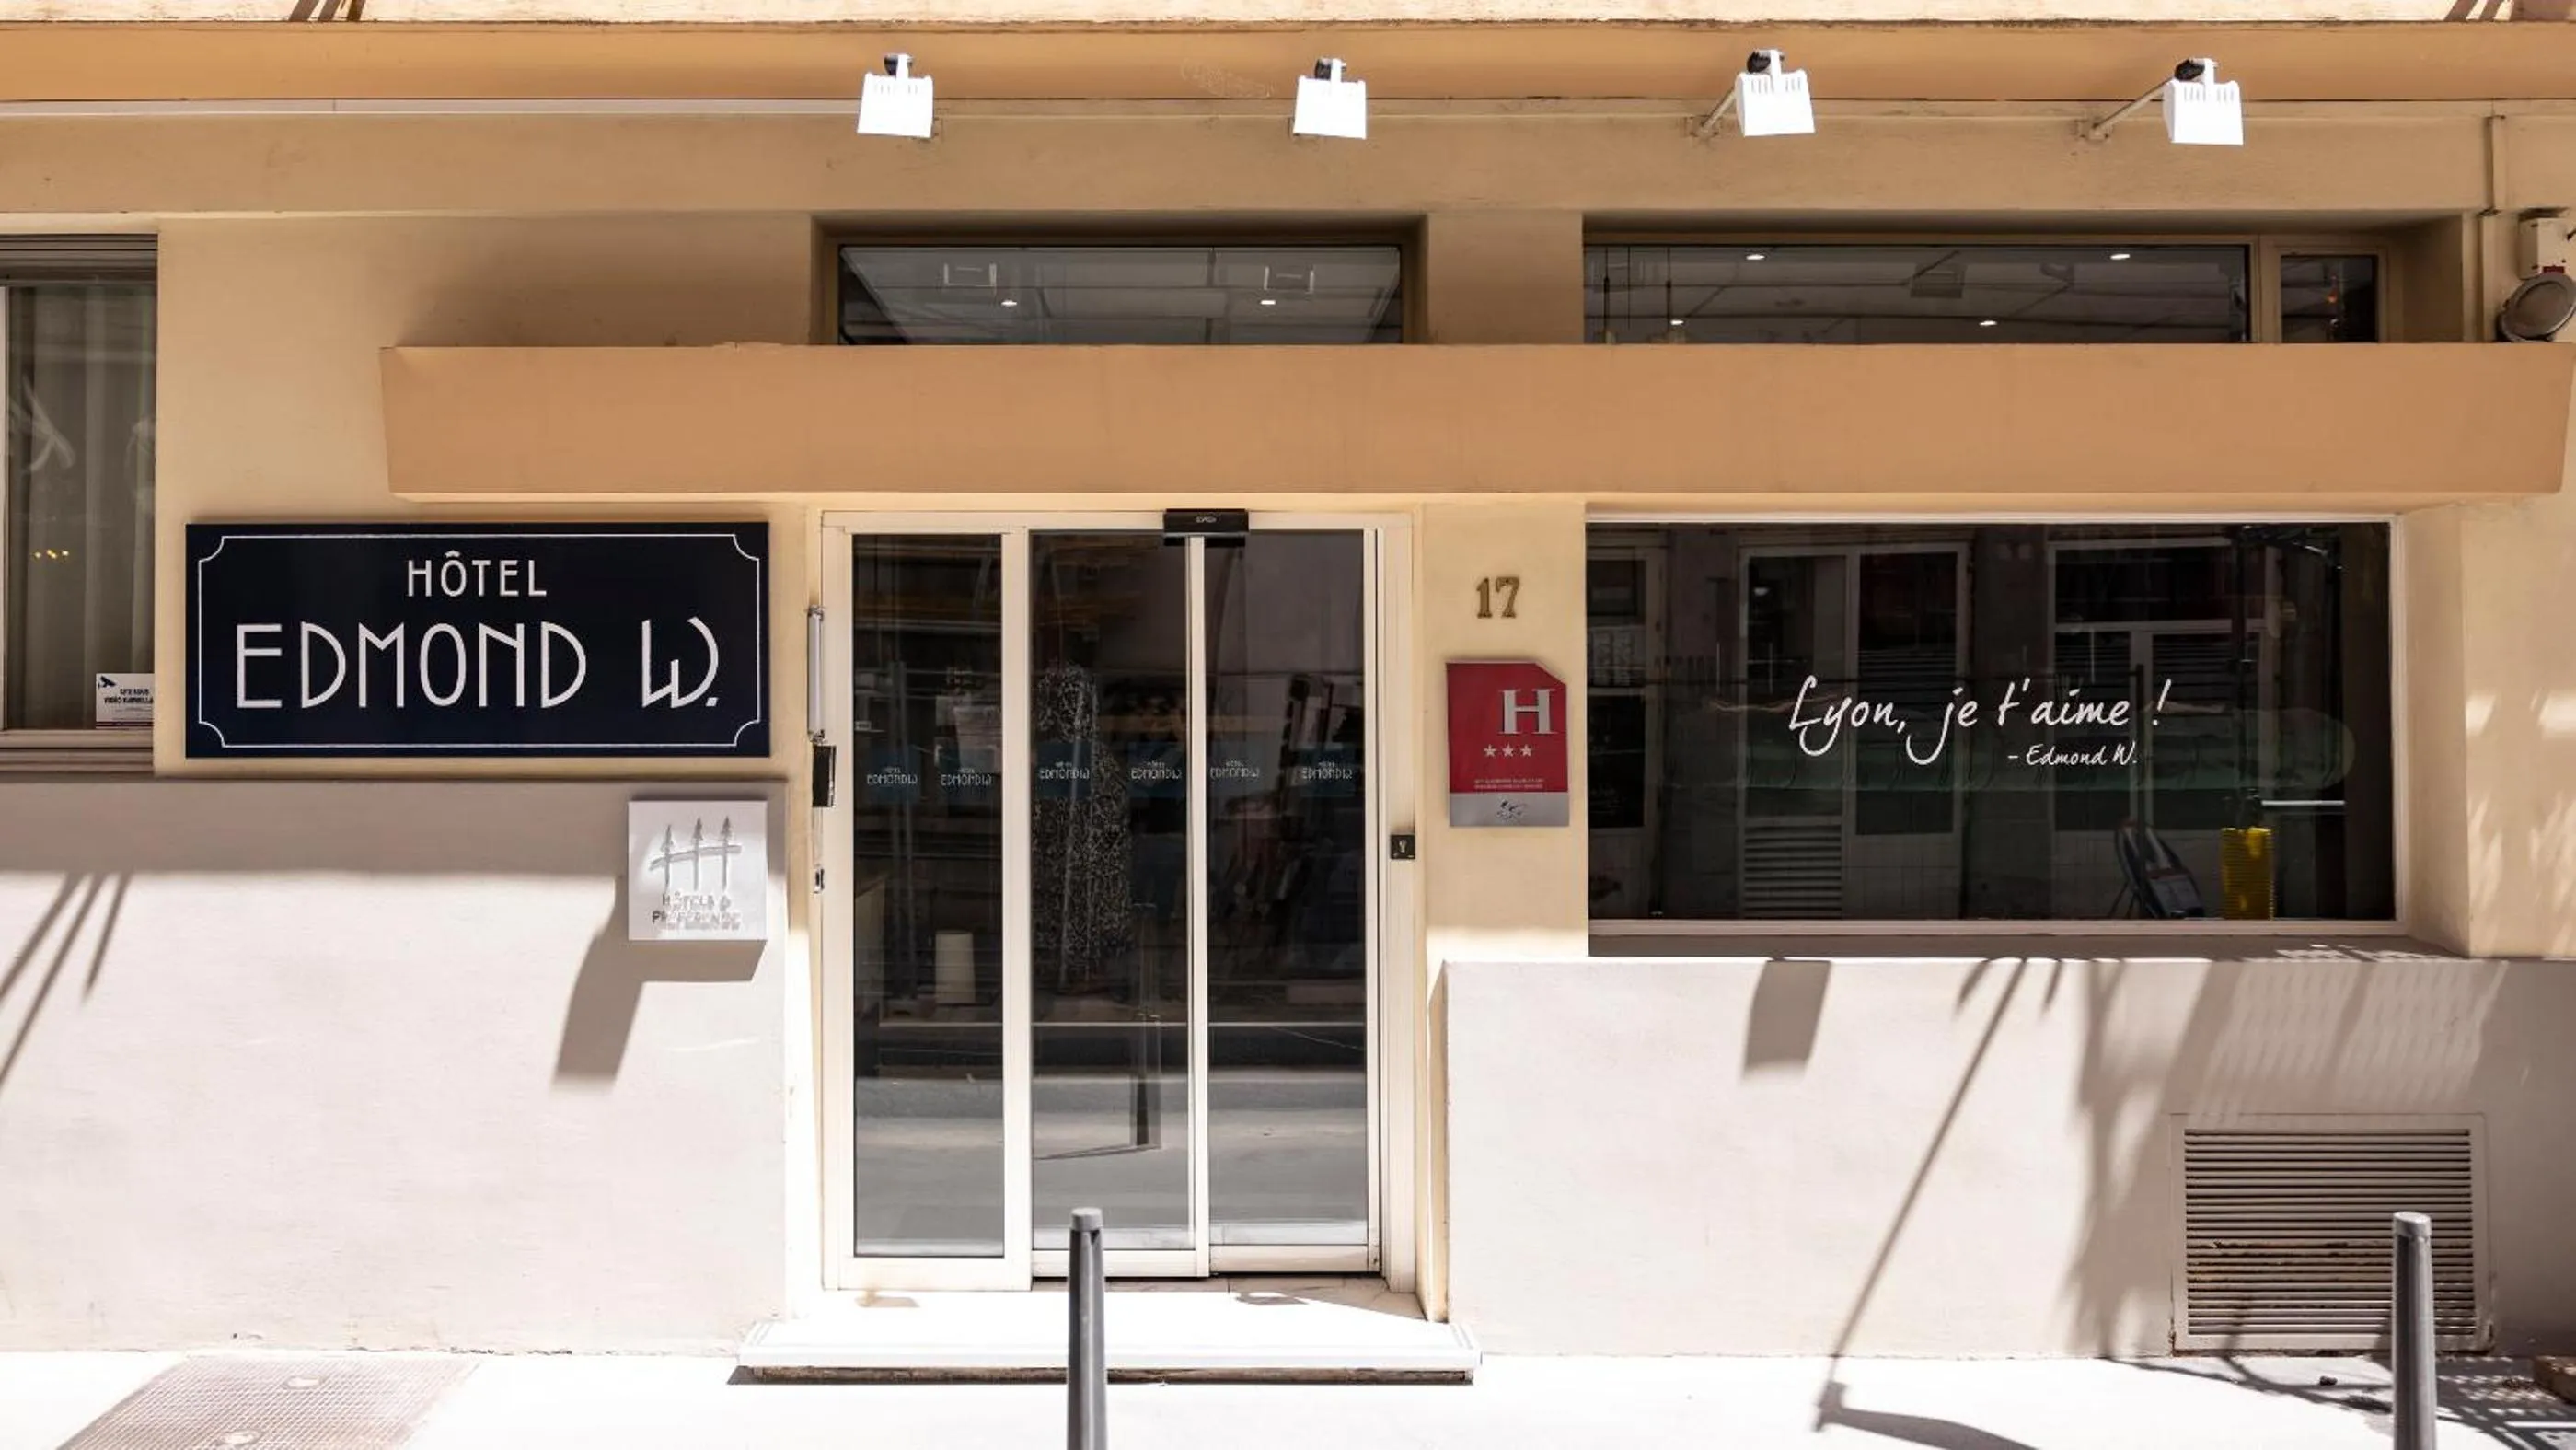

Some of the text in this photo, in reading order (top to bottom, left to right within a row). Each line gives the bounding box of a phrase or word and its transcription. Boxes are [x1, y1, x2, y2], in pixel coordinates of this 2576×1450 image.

[408, 550, 548, 597] HÔTEL
[1476, 576, 1520, 619] 17
[237, 616, 719, 709] EDMOND W.
[1498, 688, 1558, 735] H
[1788, 675, 1906, 757] Lyon,
[1905, 687, 1978, 765] je
[1998, 678, 2130, 727] t'aime
[2026, 742, 2108, 766] Edmond
